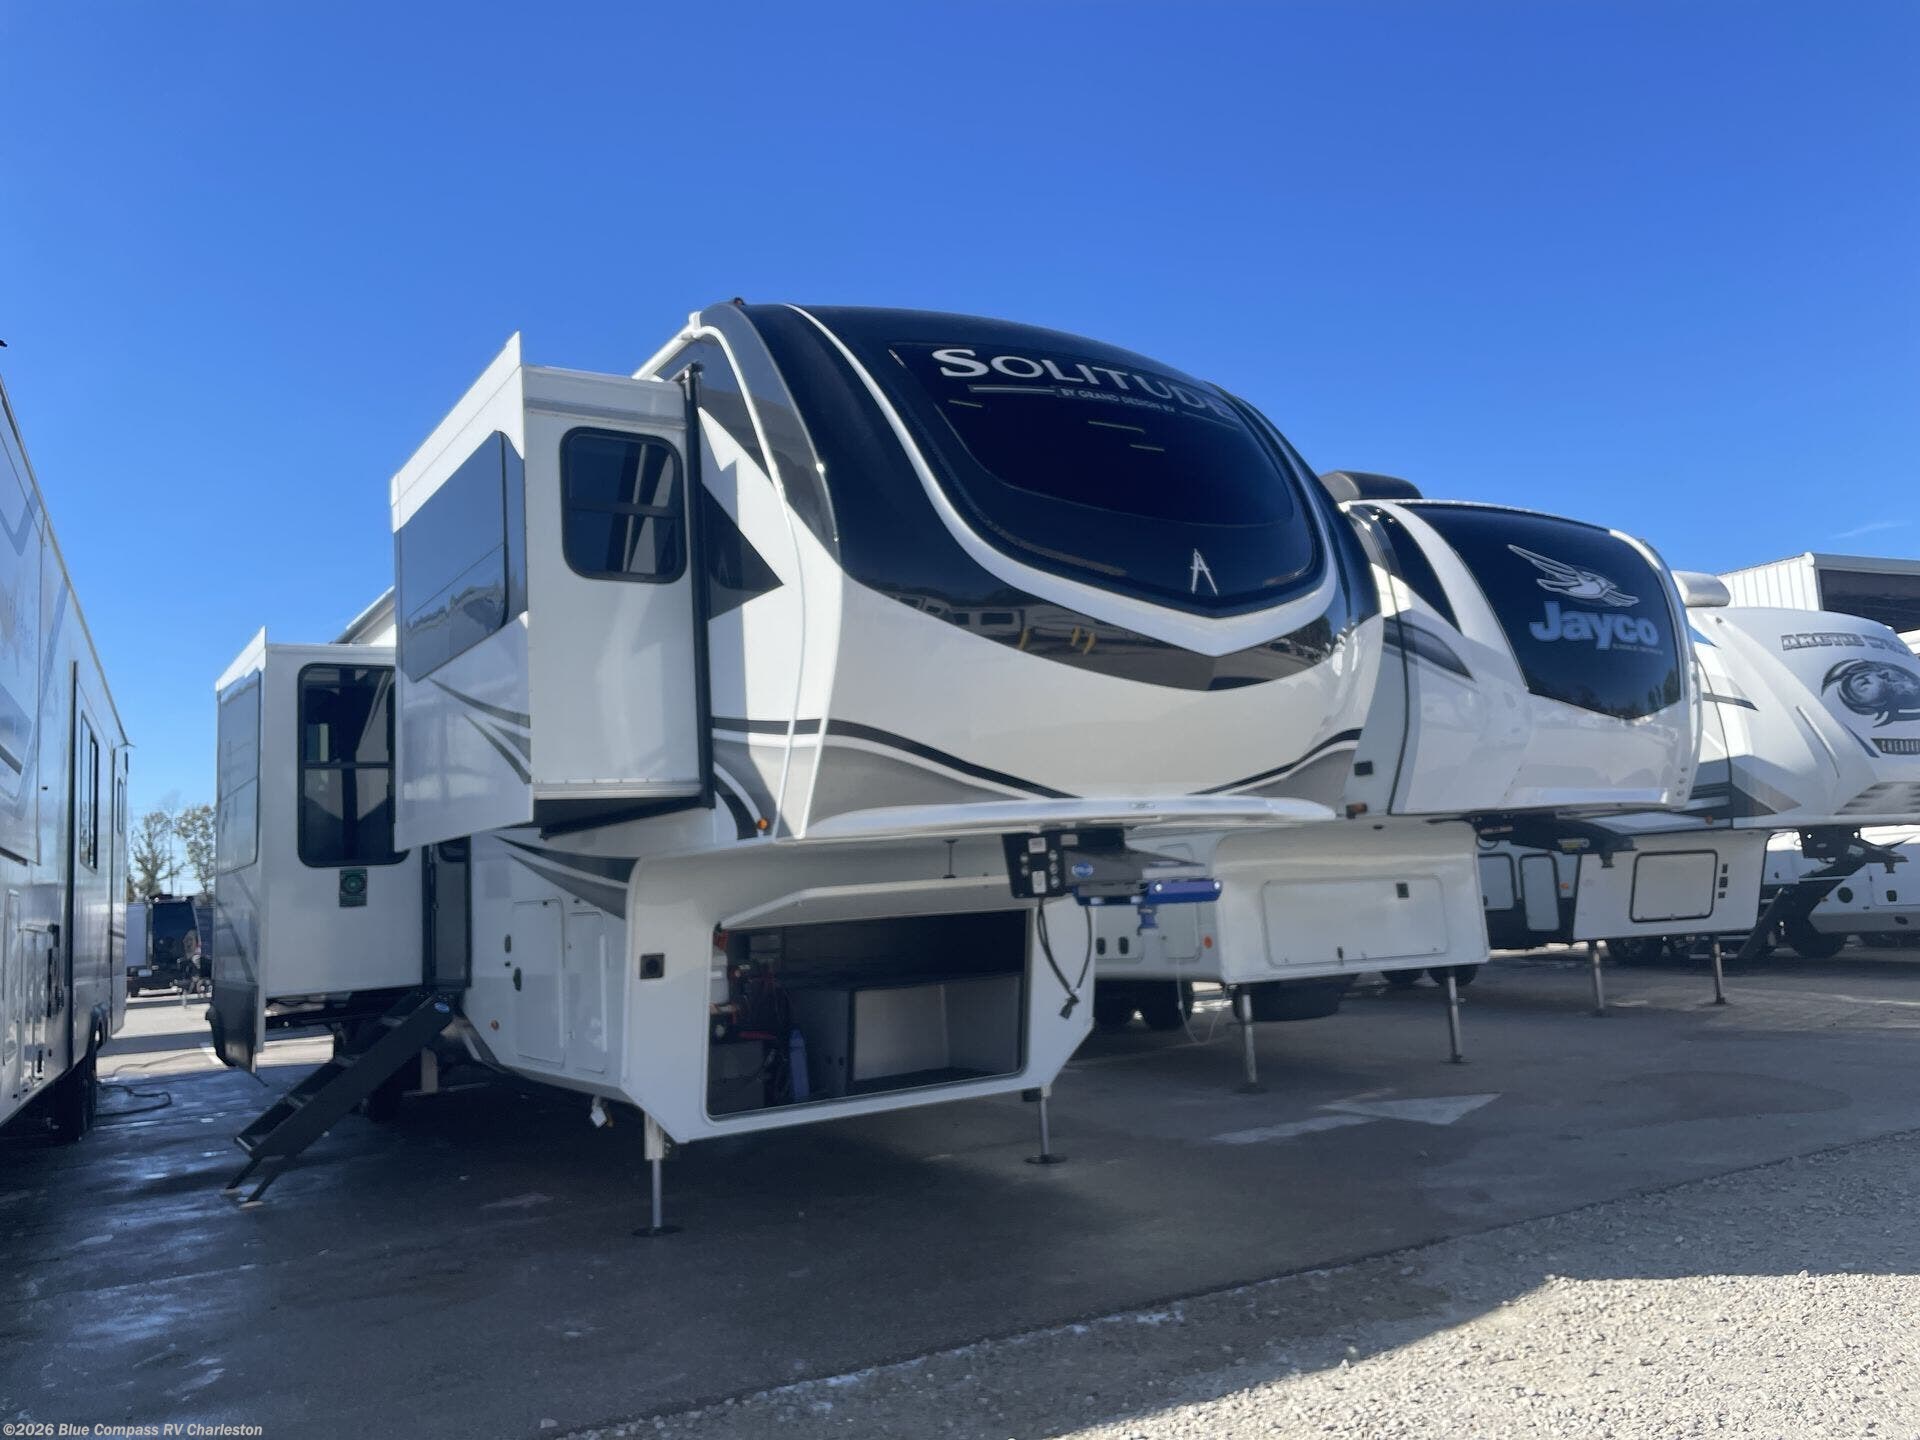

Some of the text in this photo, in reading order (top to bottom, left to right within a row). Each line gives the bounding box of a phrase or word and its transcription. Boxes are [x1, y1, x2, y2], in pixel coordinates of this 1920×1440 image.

[931, 348, 1240, 423] SOLITUDE
[1060, 388, 1075, 397] BY
[1078, 390, 1120, 402] GRAND
[1528, 600, 1660, 650] Jayco
